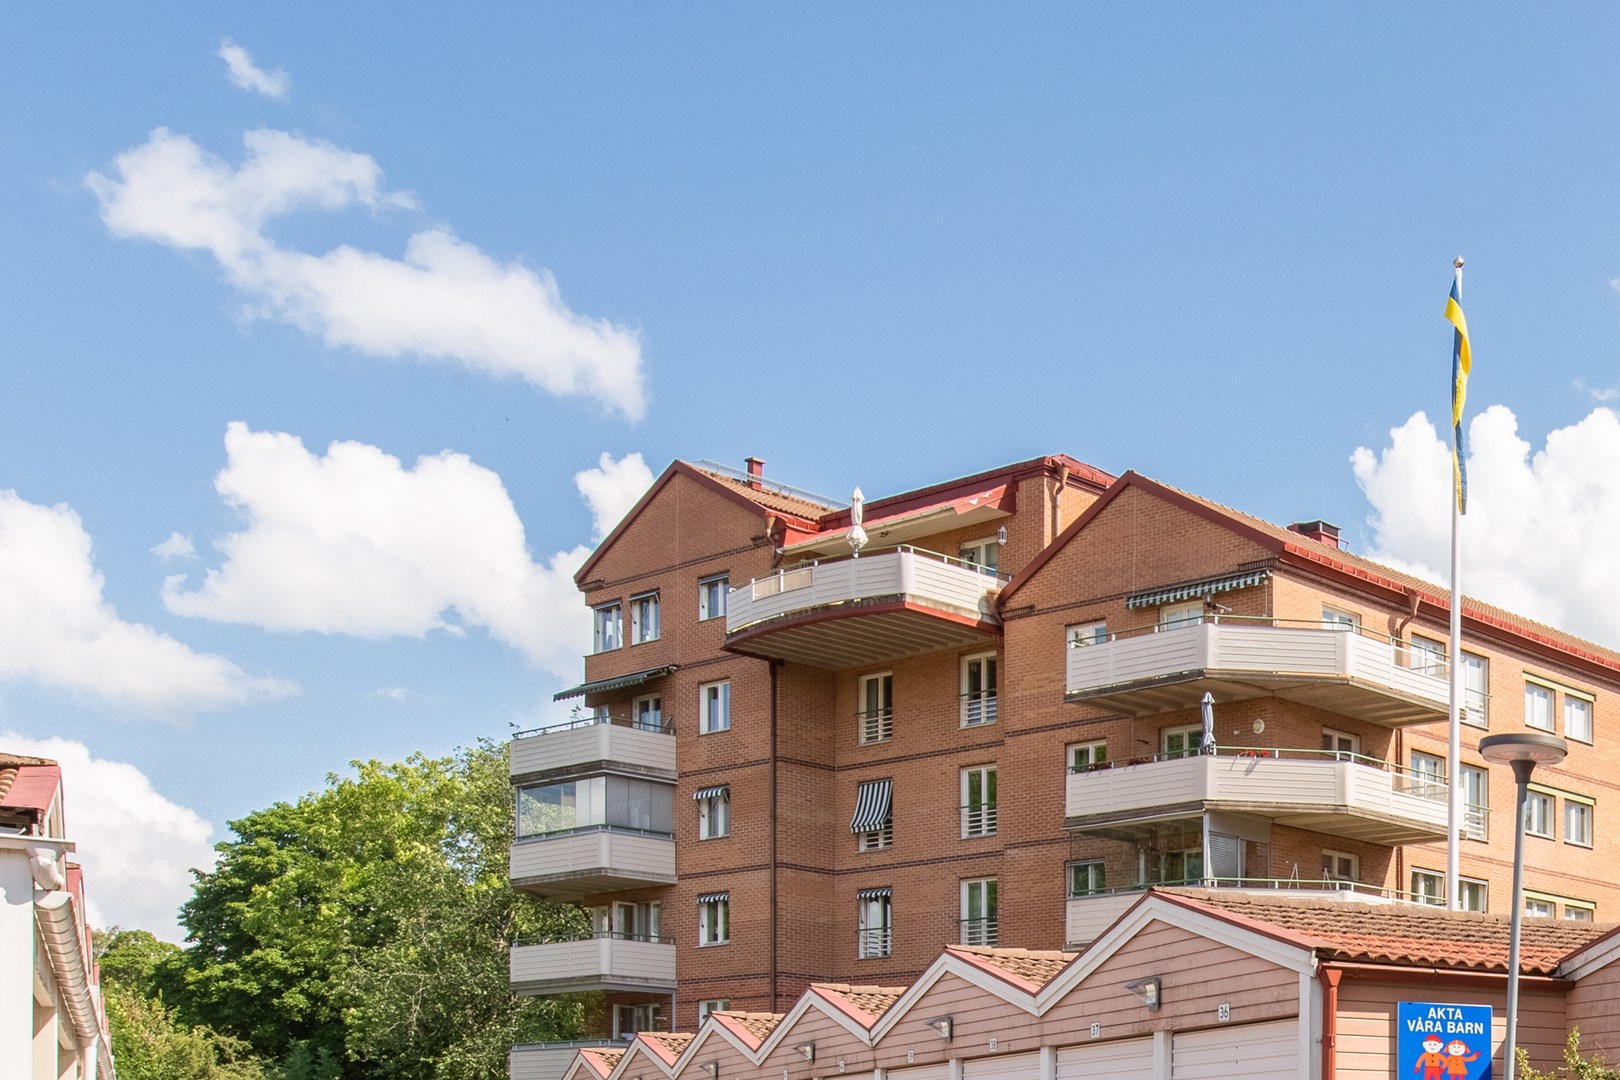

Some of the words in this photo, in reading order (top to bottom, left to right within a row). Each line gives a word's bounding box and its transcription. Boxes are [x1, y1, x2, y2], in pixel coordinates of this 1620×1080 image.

[1219, 1006, 1229, 1019] 36
[1427, 1007, 1463, 1020] AKTA
[1407, 1016, 1443, 1033] VÅRA
[1447, 1021, 1484, 1035] BARN
